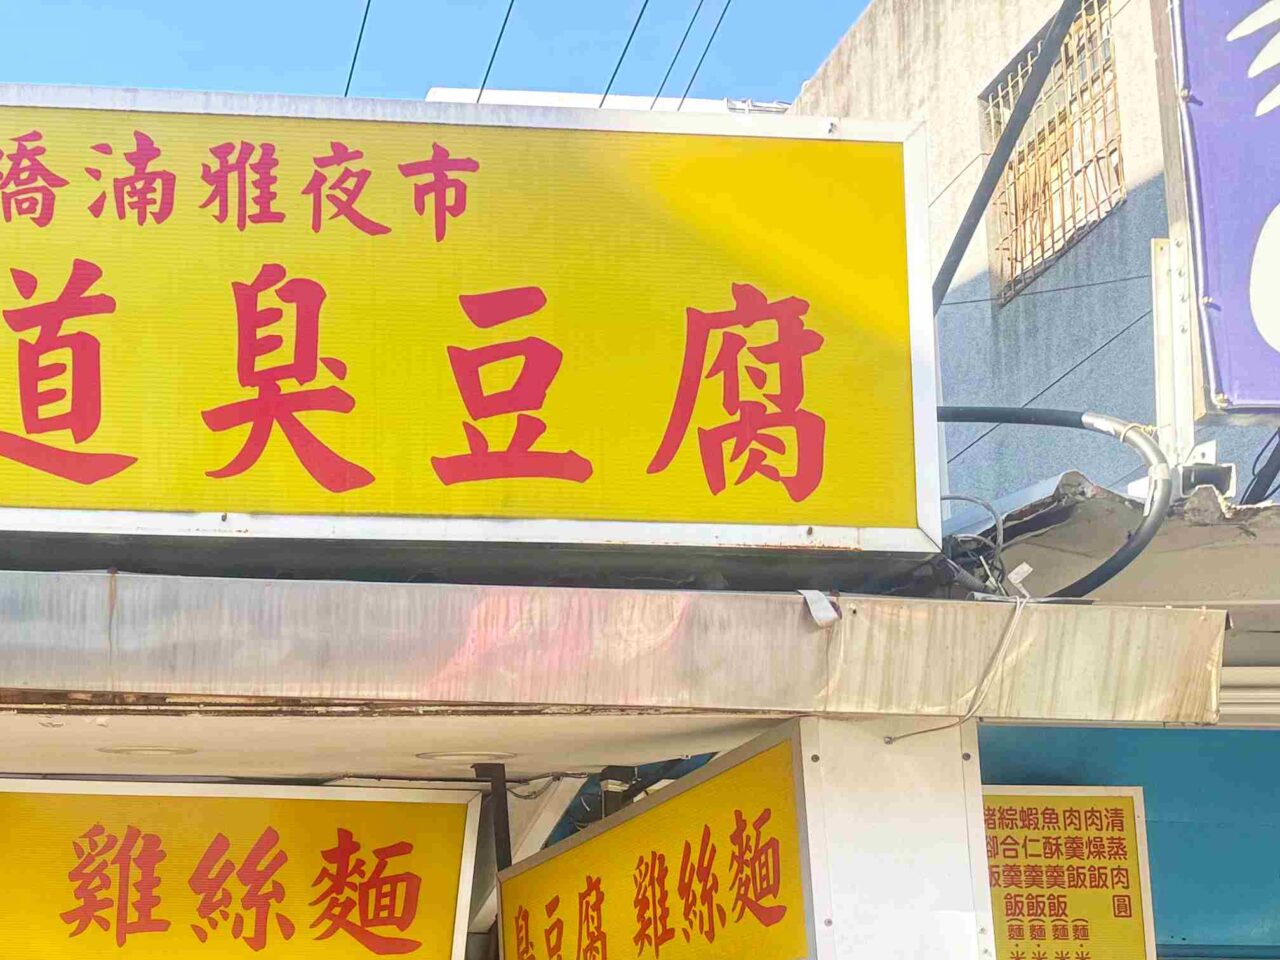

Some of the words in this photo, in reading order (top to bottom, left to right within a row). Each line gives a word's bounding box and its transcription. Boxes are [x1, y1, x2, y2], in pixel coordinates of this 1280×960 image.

[59, 822, 424, 956] 雞絲麵
[632, 808, 788, 960] 雞絲麵
